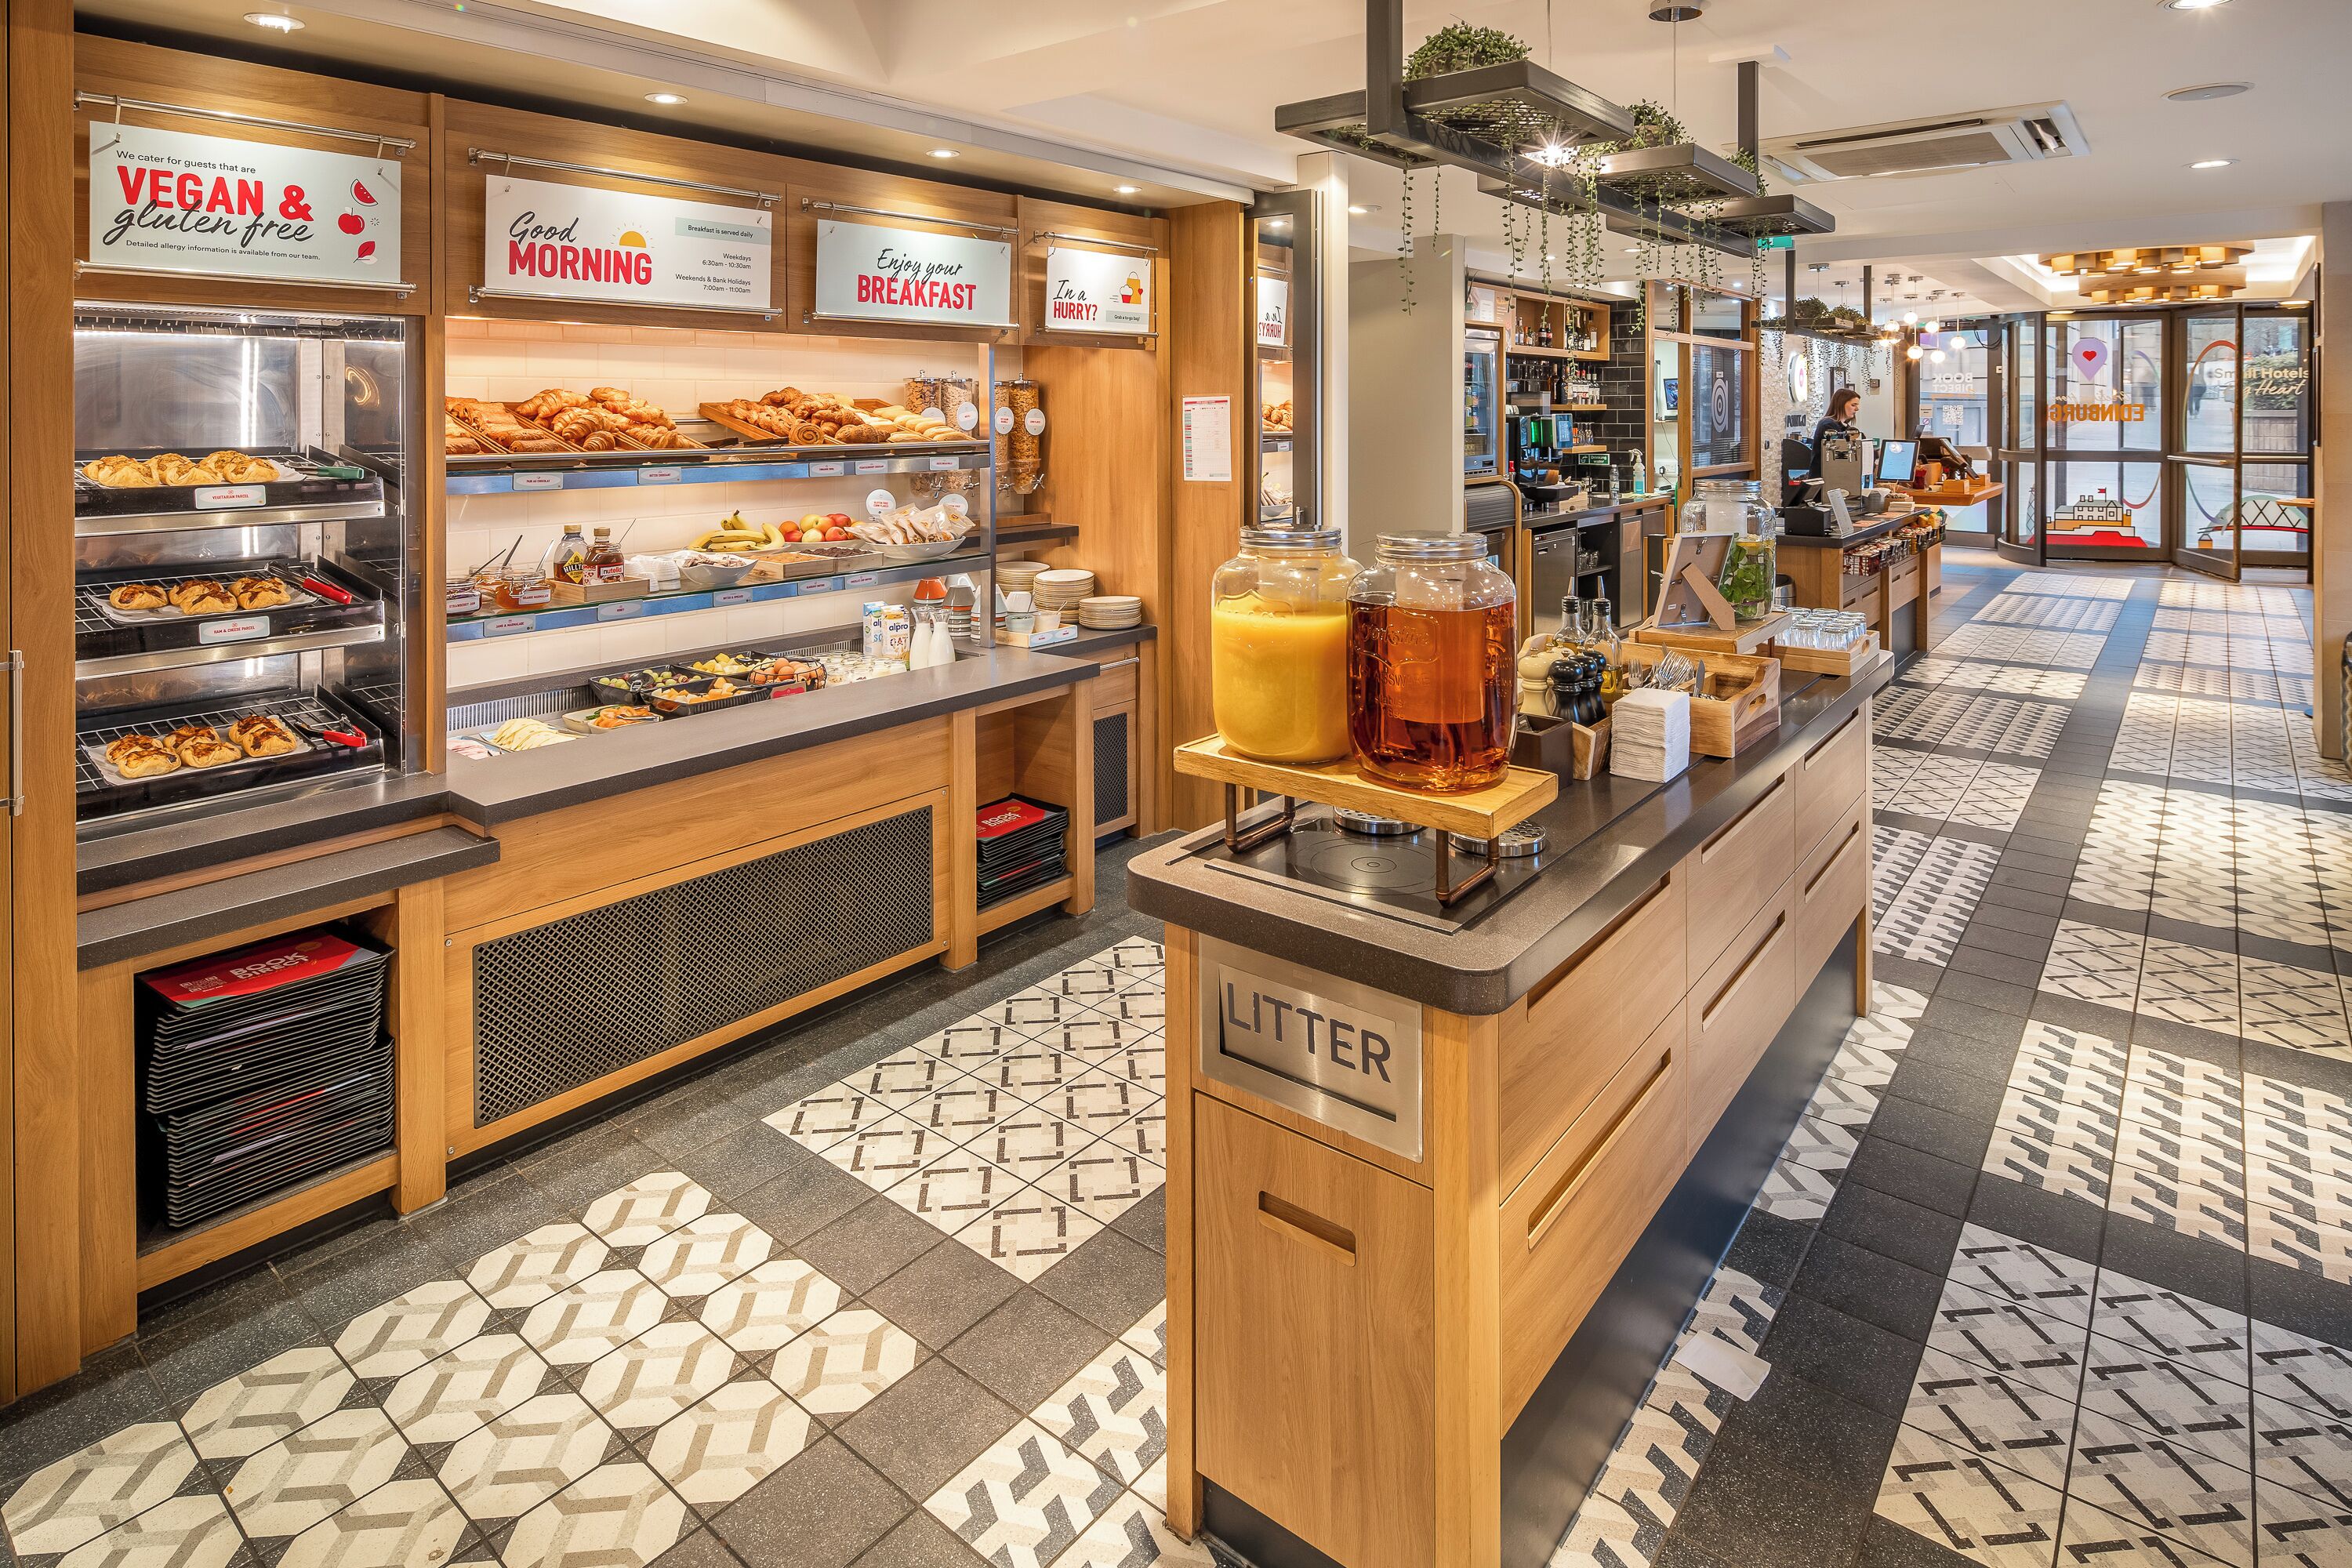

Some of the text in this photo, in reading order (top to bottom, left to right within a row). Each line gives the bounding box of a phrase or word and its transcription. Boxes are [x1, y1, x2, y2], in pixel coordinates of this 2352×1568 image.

[116, 150, 135, 160] We
[137, 154, 165, 163] cater
[167, 156, 182, 165] for
[184, 159, 216, 169] guests
[219, 162, 238, 172] that
[117, 165, 314, 222] VEGAN &
[102, 198, 314, 249] gluten free
[509, 210, 580, 245] Good
[688, 224, 714, 234] Breakfast
[739, 230, 753, 239] daily
[125, 240, 158, 249] Detailed
[187, 245, 230, 254] information
[722, 252, 751, 263] Weekdays
[509, 239, 652, 285] MORNING
[877, 248, 964, 285] Enjoy your
[675, 273, 706, 282] Weekends
[857, 274, 977, 310] BREAKFAST
[1052, 279, 1087, 301] In a
[1053, 300, 1098, 321] HURRY?
[2214, 366, 2309, 379] Smll Hotels
[2254, 378, 2307, 396] Heart
[563, 564, 583, 573] HILLT
[888, 622, 909, 633] alpro
[981, 811, 1017, 825] BOOK
[988, 814, 1022, 827] DIRECT
[229, 952, 308, 976] BOOK
[237, 956, 309, 979] DIRECT
[1227, 981, 1392, 1083] LITTER
